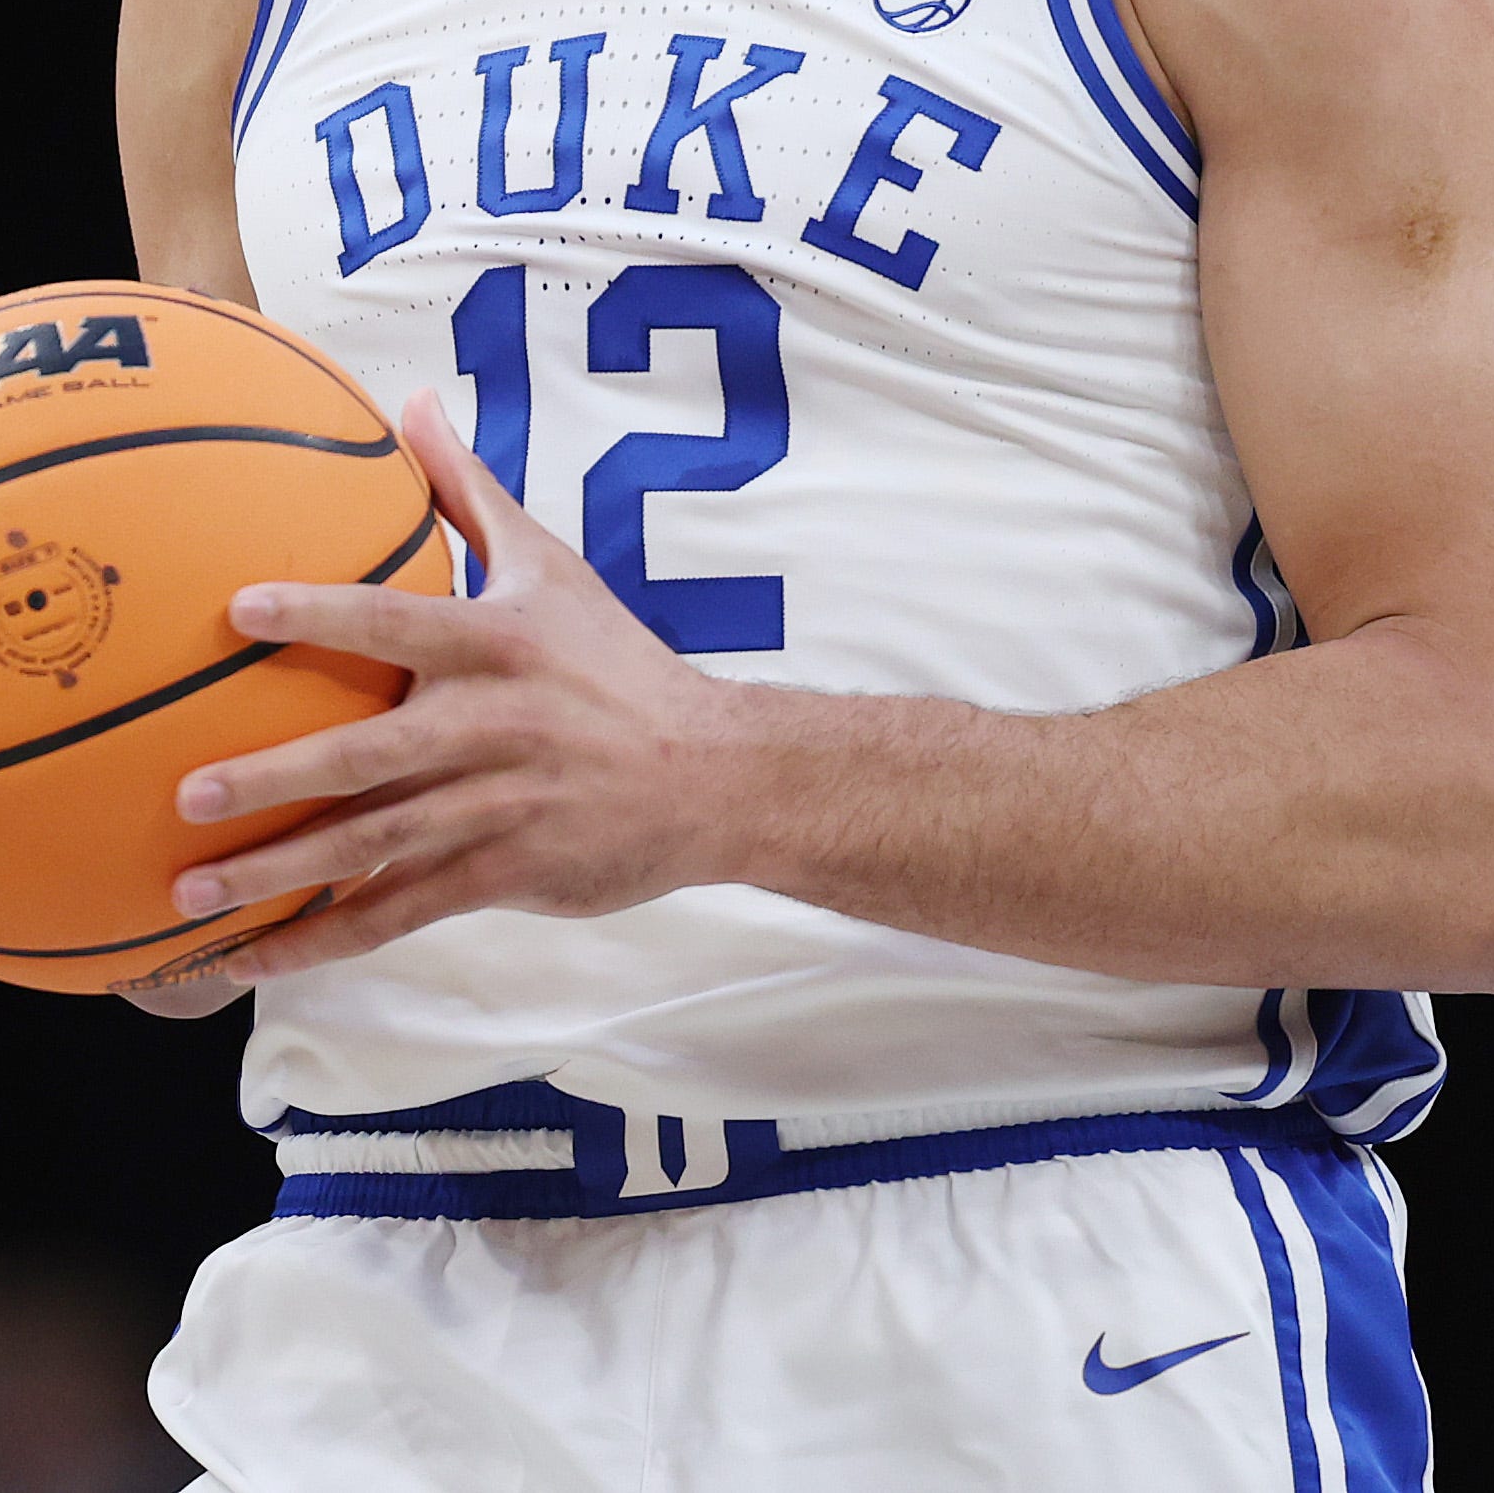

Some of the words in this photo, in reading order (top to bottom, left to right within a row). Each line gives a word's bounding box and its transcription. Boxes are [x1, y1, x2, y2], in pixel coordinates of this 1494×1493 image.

[315, 32, 1002, 292] DUKE
[63, 376, 150, 392] BALL
[451, 264, 790, 655] 12
